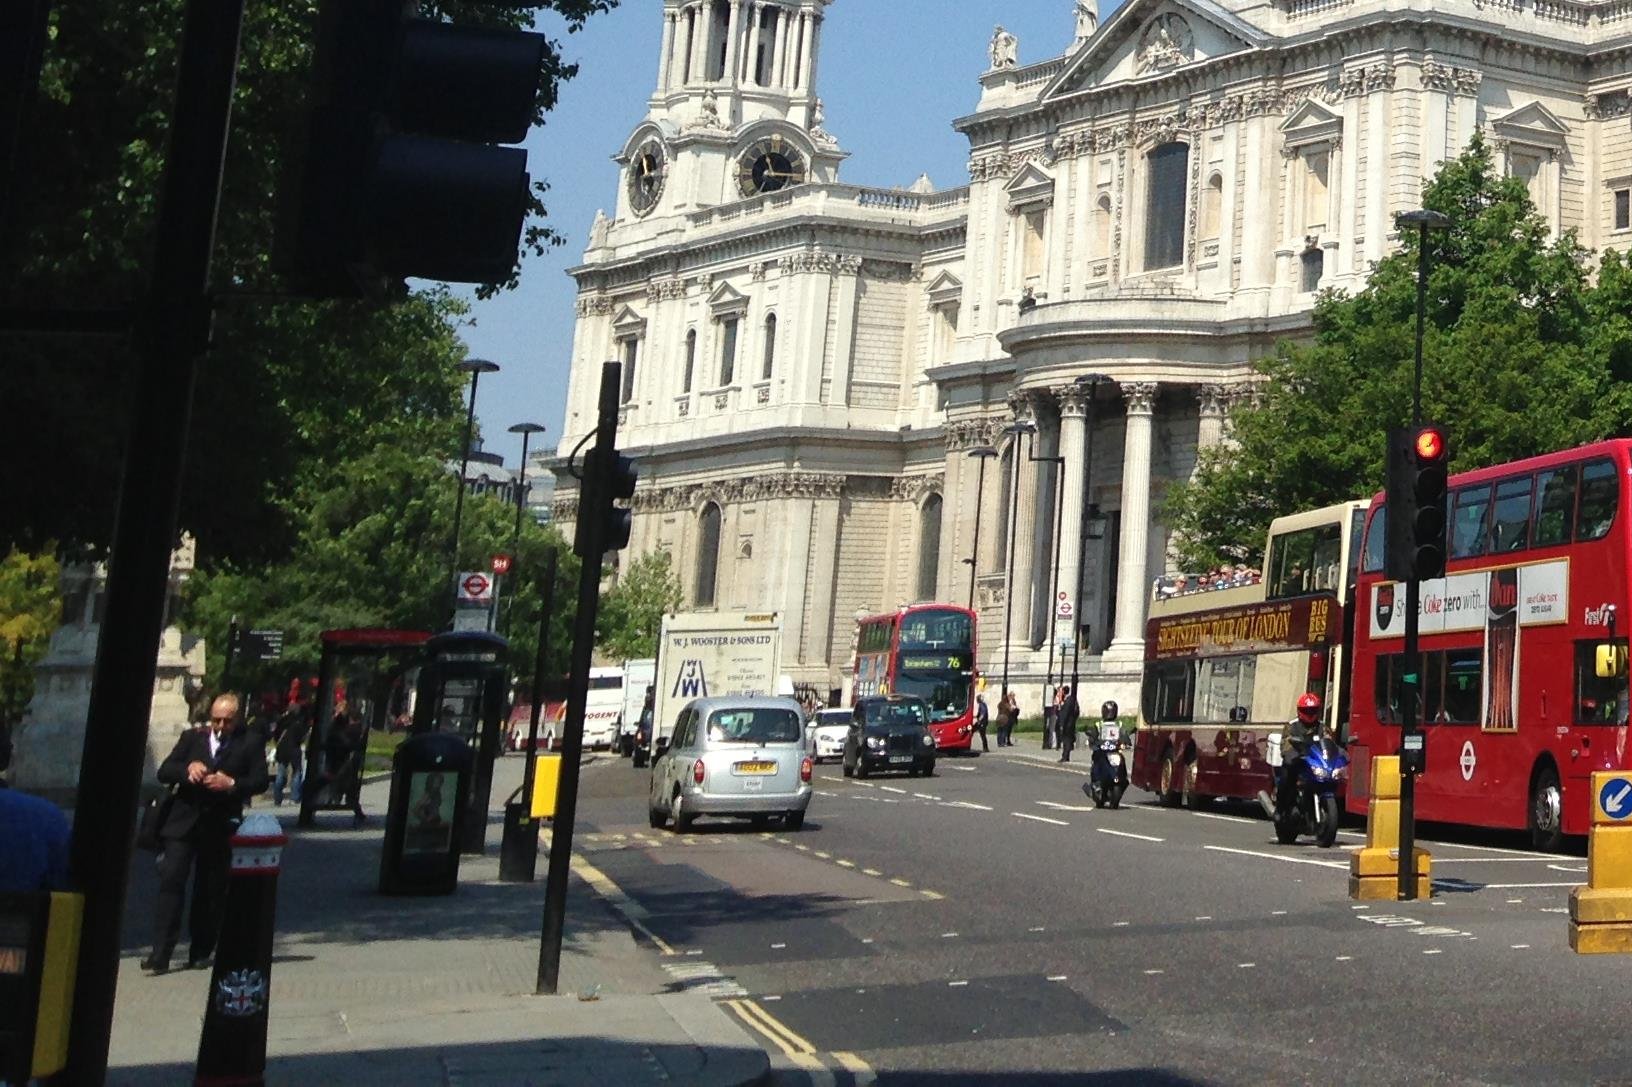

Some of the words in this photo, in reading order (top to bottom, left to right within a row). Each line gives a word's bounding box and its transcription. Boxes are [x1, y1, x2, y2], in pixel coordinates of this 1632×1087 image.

[1310, 599, 1328, 616] BIG
[1424, 593, 1441, 614] Coke
[1443, 595, 1461, 612] zero
[1211, 618, 1235, 645] TOUR
[1235, 616, 1250, 642] OF
[1250, 612, 1291, 641] LONDON
[1309, 615, 1327, 632] BUS
[691, 636, 728, 646] WOOSTER
[736, 636, 755, 645] SONS
[756, 635, 771, 644] LTD
[947, 656, 960, 669] 76
[585, 711, 618, 719] OGENT
